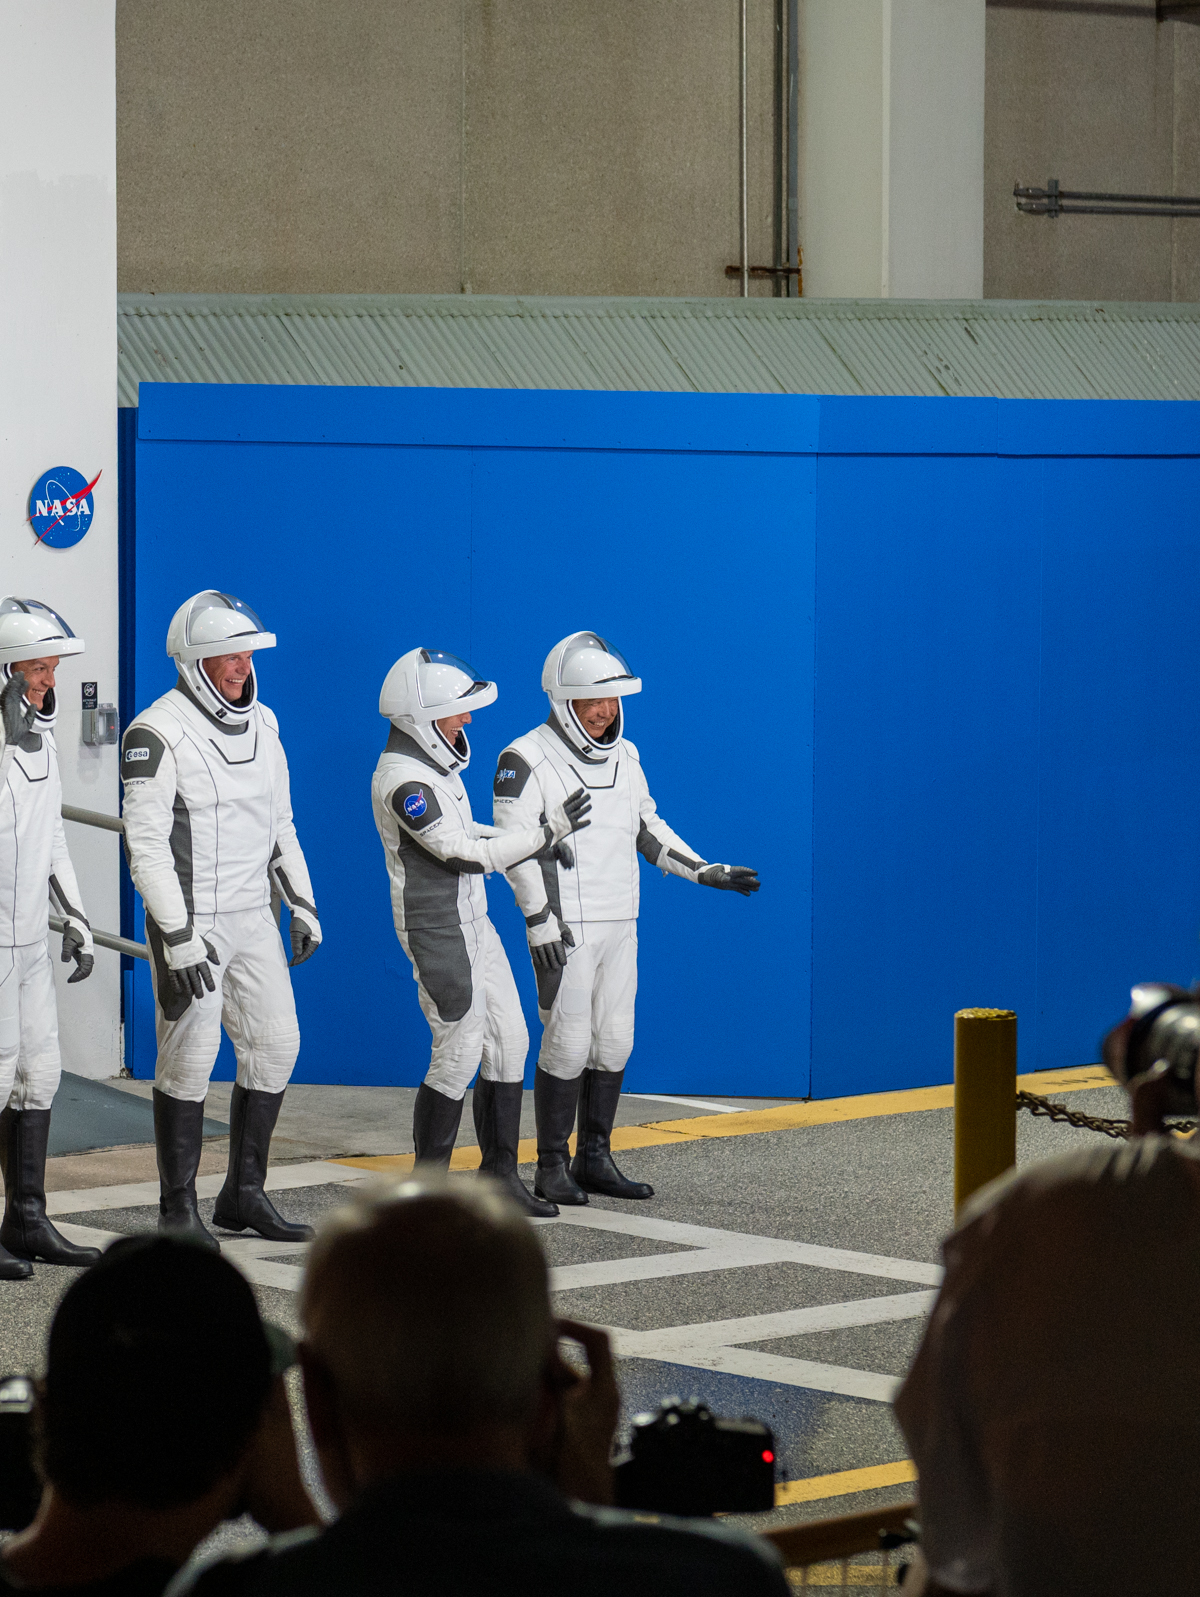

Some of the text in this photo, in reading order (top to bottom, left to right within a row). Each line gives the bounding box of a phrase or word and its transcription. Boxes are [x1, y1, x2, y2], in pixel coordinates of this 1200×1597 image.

[35, 498, 91, 517] NASA
[407, 799, 425, 812] NASA
[419, 816, 444, 837] SPACEX
